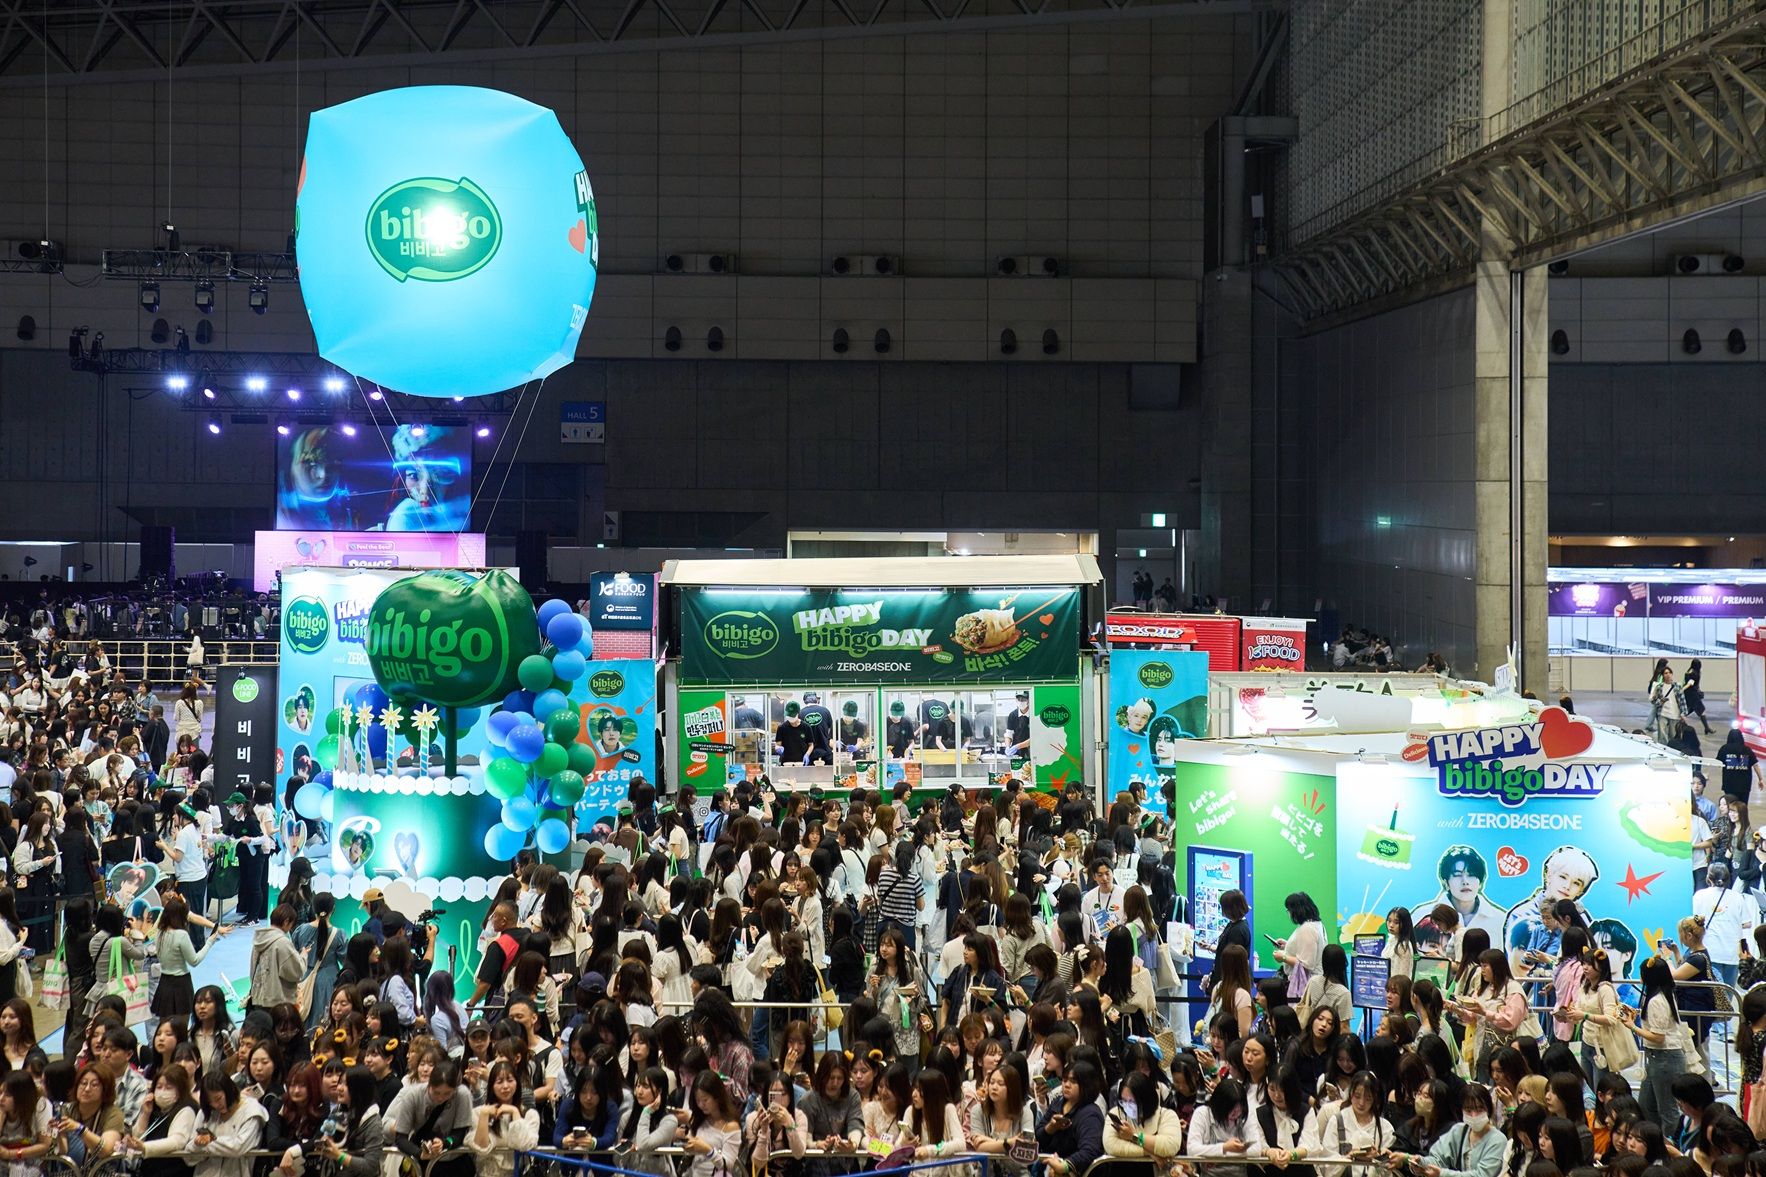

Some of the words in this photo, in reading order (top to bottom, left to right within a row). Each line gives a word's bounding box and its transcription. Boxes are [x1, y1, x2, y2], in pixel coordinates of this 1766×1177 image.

[380, 206, 491, 250] bibgo
[590, 406, 598, 420] 5
[615, 583, 646, 594] FOOD
[1673, 596, 1713, 604] PREMIUM
[1722, 596, 1764, 604] PREMIUM
[798, 600, 884, 629] HAPPY
[290, 610, 327, 636] bibigo
[711, 624, 774, 645] bibigo
[1256, 634, 1295, 648] ENJOY!
[367, 607, 493, 678] bibigo
[722, 640, 749, 649] 비비고
[1262, 645, 1301, 661] FOOD
[381, 660, 435, 685] 비비고
[816, 663, 834, 671] with
[1141, 669, 1172, 681] bibigo
[592, 678, 623, 689] bibigo
[1043, 711, 1069, 722] bibigo
[1433, 722, 1545, 762] HAPPY
[1403, 745, 1429, 759] Delicious
[586, 769, 644, 782] っておきの
[1129, 774, 1176, 788] みんな
[1189, 790, 1217, 814] Let's
[1195, 805, 1237, 836] bibigo!
[1436, 815, 1464, 829] with
[1498, 858, 1521, 876] PARTY
